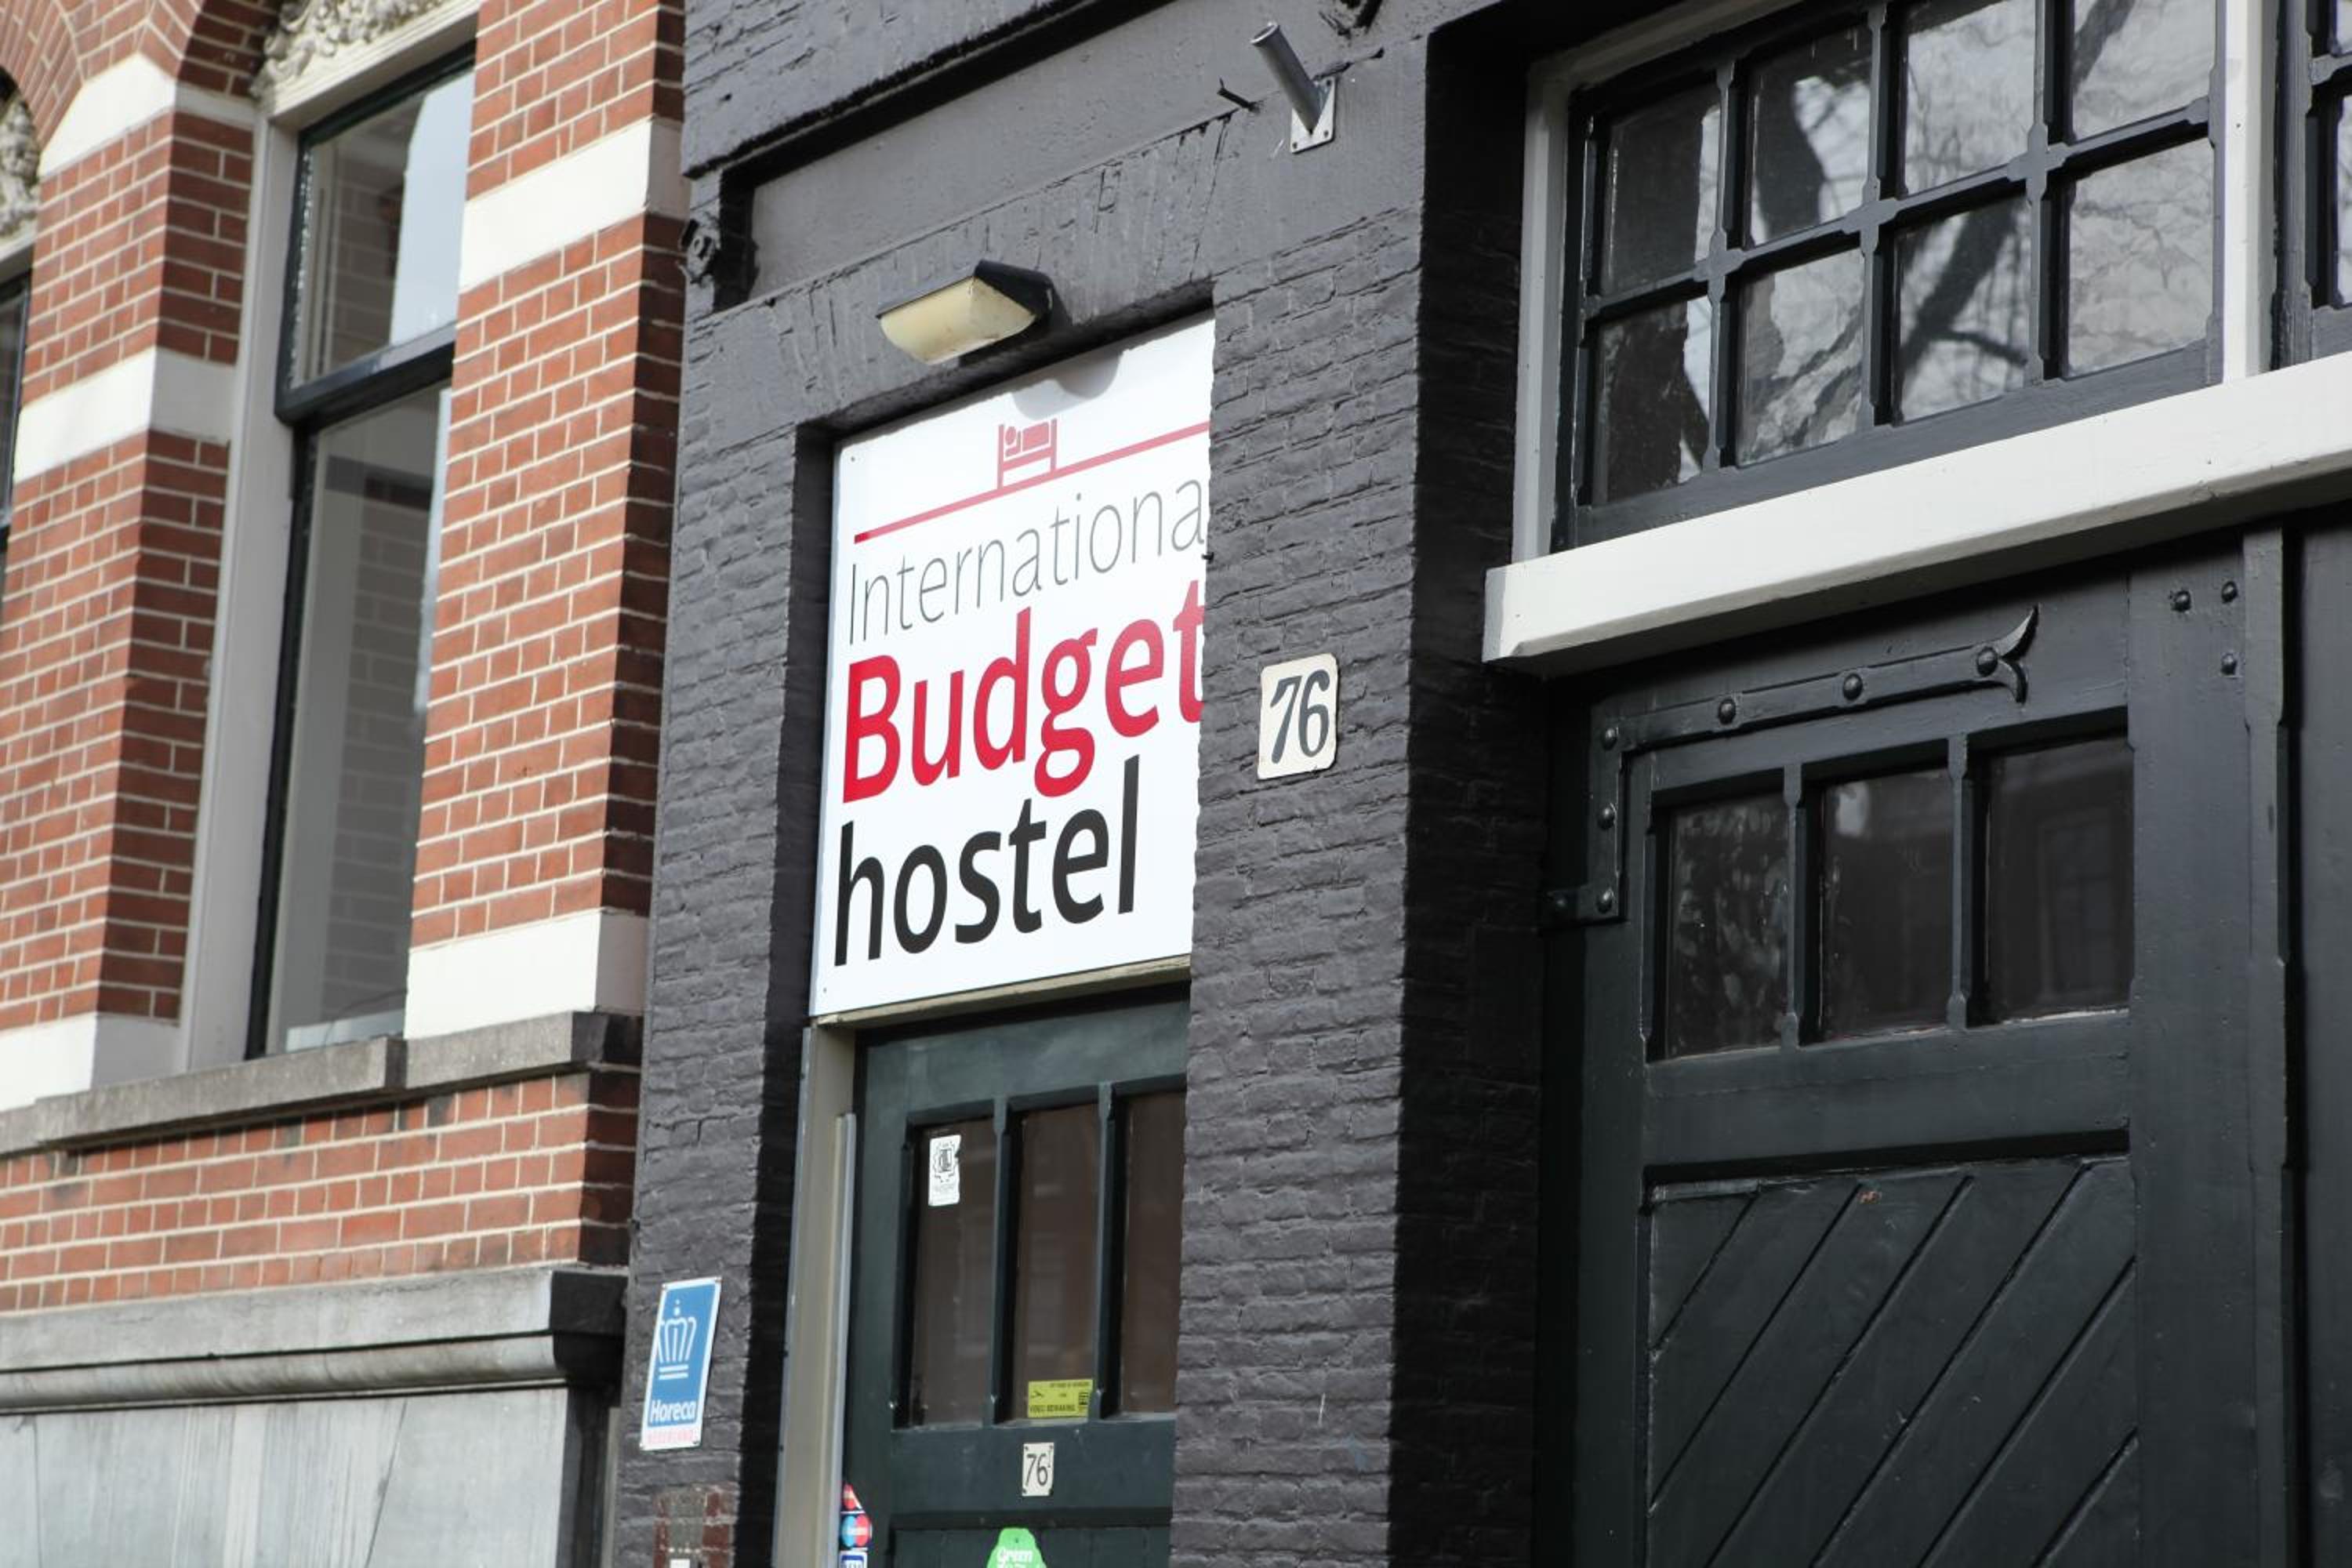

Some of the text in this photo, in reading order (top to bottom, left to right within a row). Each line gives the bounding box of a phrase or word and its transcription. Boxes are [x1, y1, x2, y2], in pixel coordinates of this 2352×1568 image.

[843, 580, 1203, 804] Budget
[1270, 670, 1330, 764] 76
[834, 754, 1139, 967] hostel
[650, 1399, 697, 1422] Horeca
